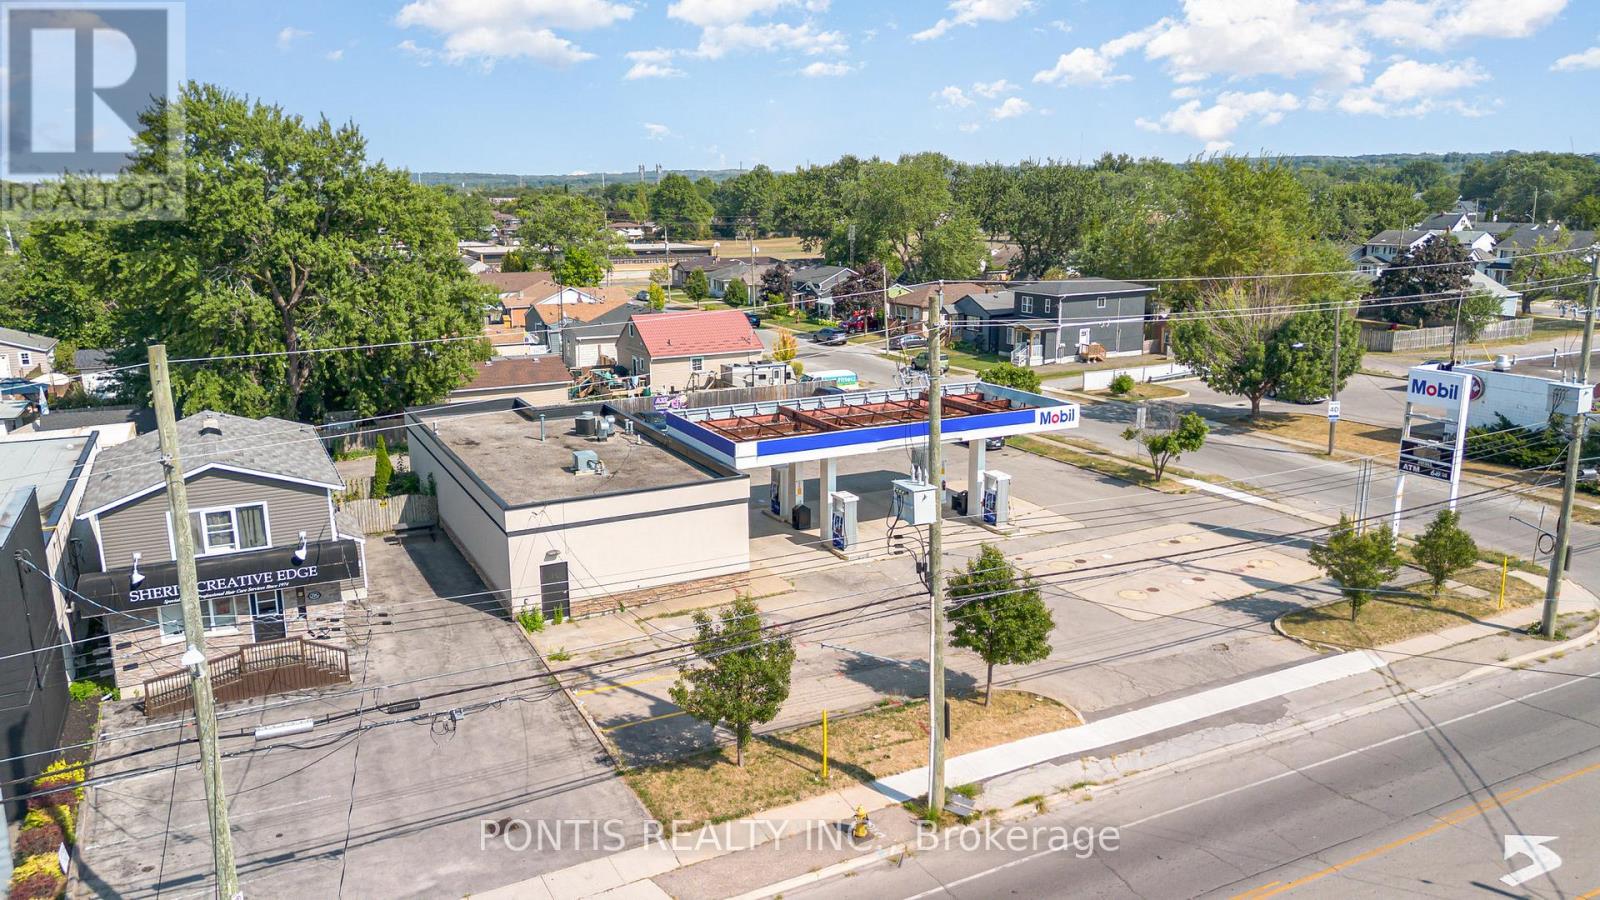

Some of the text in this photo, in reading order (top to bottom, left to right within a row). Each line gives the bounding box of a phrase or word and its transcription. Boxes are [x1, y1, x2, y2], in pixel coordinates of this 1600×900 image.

[1412, 379, 1459, 400] Mobil
[1040, 408, 1075, 425] Mobil
[1403, 463, 1420, 473] ATM
[196, 572, 273, 592] CREATIVE
[276, 566, 318, 582] EDGE
